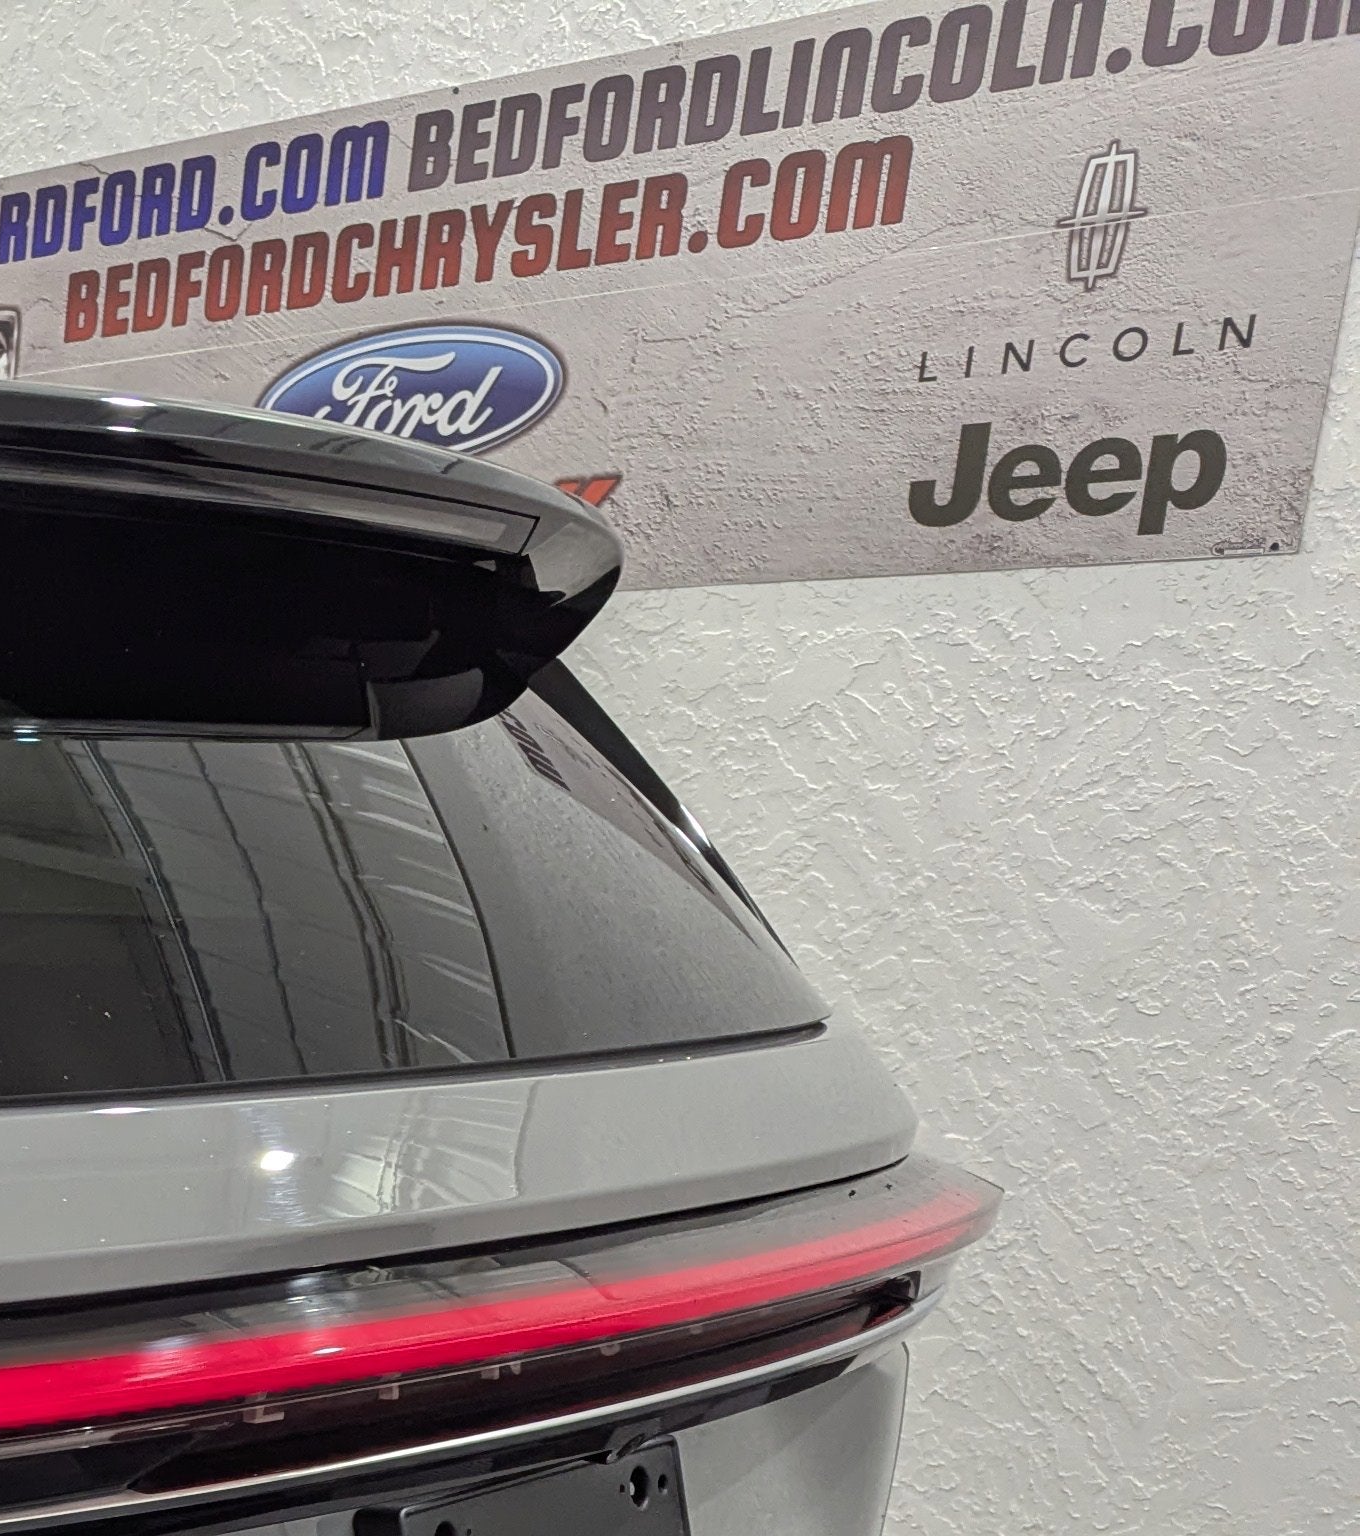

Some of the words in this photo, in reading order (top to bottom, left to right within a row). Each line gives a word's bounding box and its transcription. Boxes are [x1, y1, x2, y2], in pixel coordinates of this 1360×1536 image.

[64, 135, 914, 343] BEDFORDCHRYSLER.COM
[310, 351, 503, 438] Ford
[917, 314, 1257, 383] LINCOLN
[908, 422, 1227, 536] Jeep
